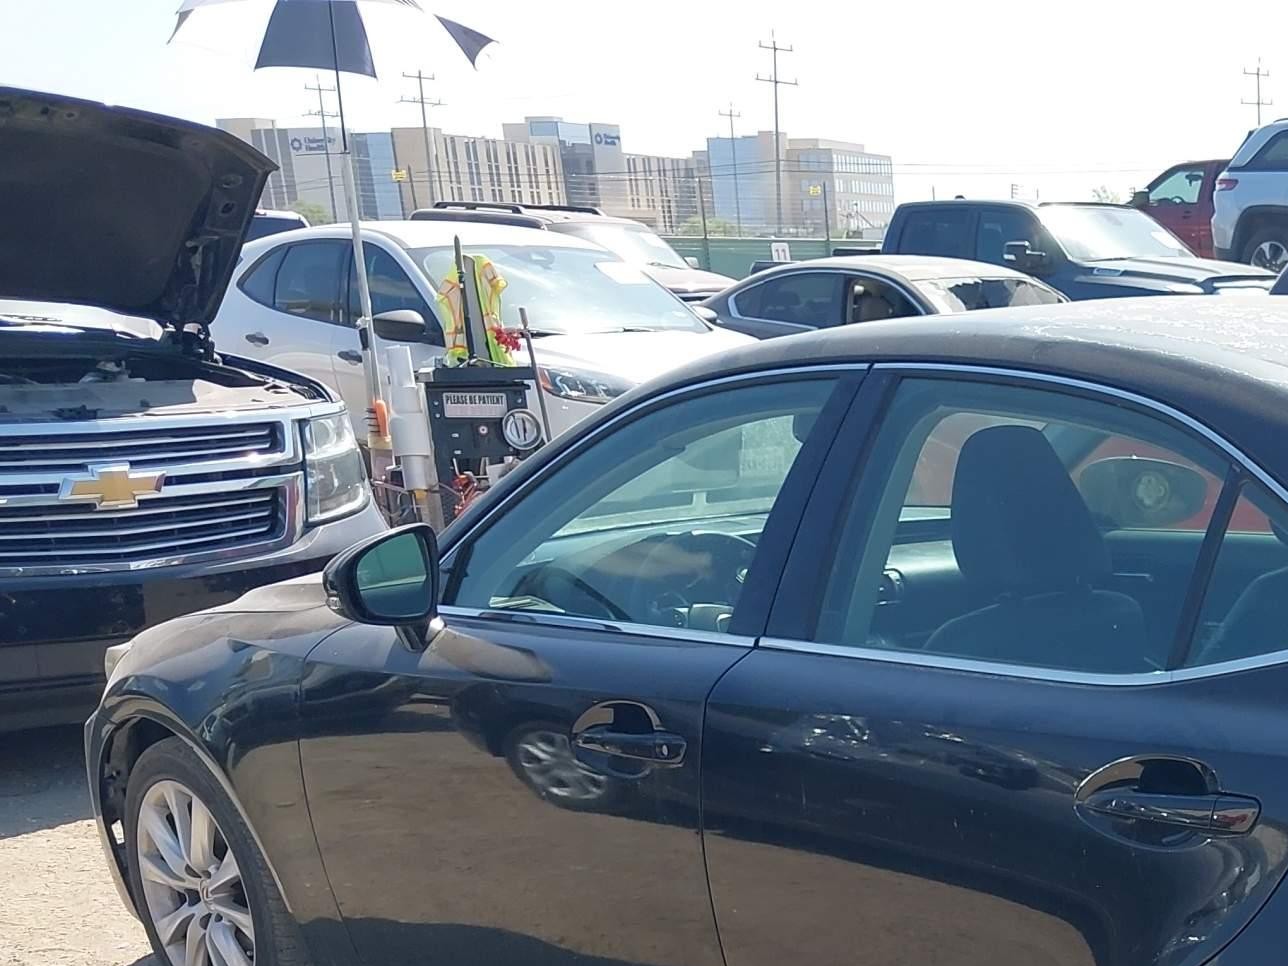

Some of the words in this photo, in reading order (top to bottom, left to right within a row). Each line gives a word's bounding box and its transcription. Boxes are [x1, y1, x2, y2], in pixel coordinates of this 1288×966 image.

[445, 394, 468, 405] PLEASE
[468, 394, 478, 405] BE
[478, 395, 504, 405] PATIENT
